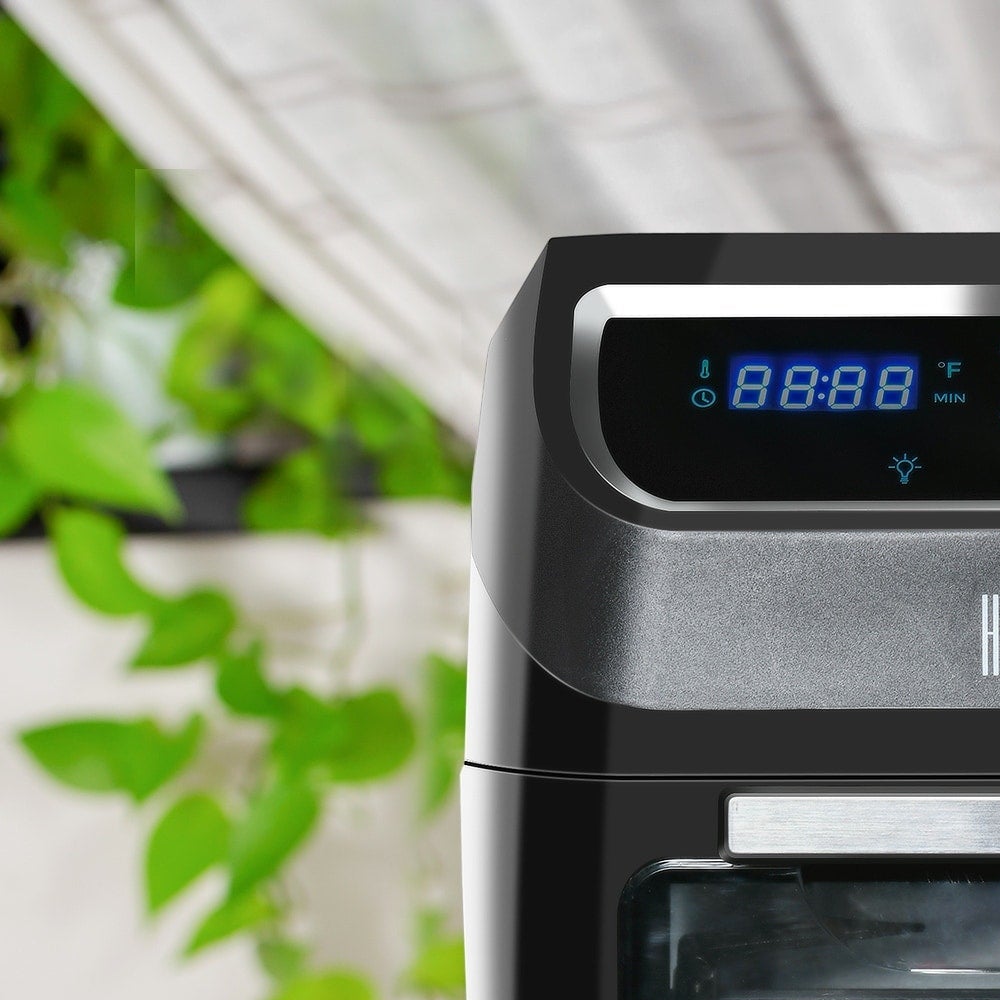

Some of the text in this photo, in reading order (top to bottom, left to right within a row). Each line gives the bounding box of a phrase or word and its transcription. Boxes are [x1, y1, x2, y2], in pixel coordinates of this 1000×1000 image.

[937, 361, 962, 379] °F
[732, 365, 914, 410] 88:88
[933, 392, 966, 404] MIN
